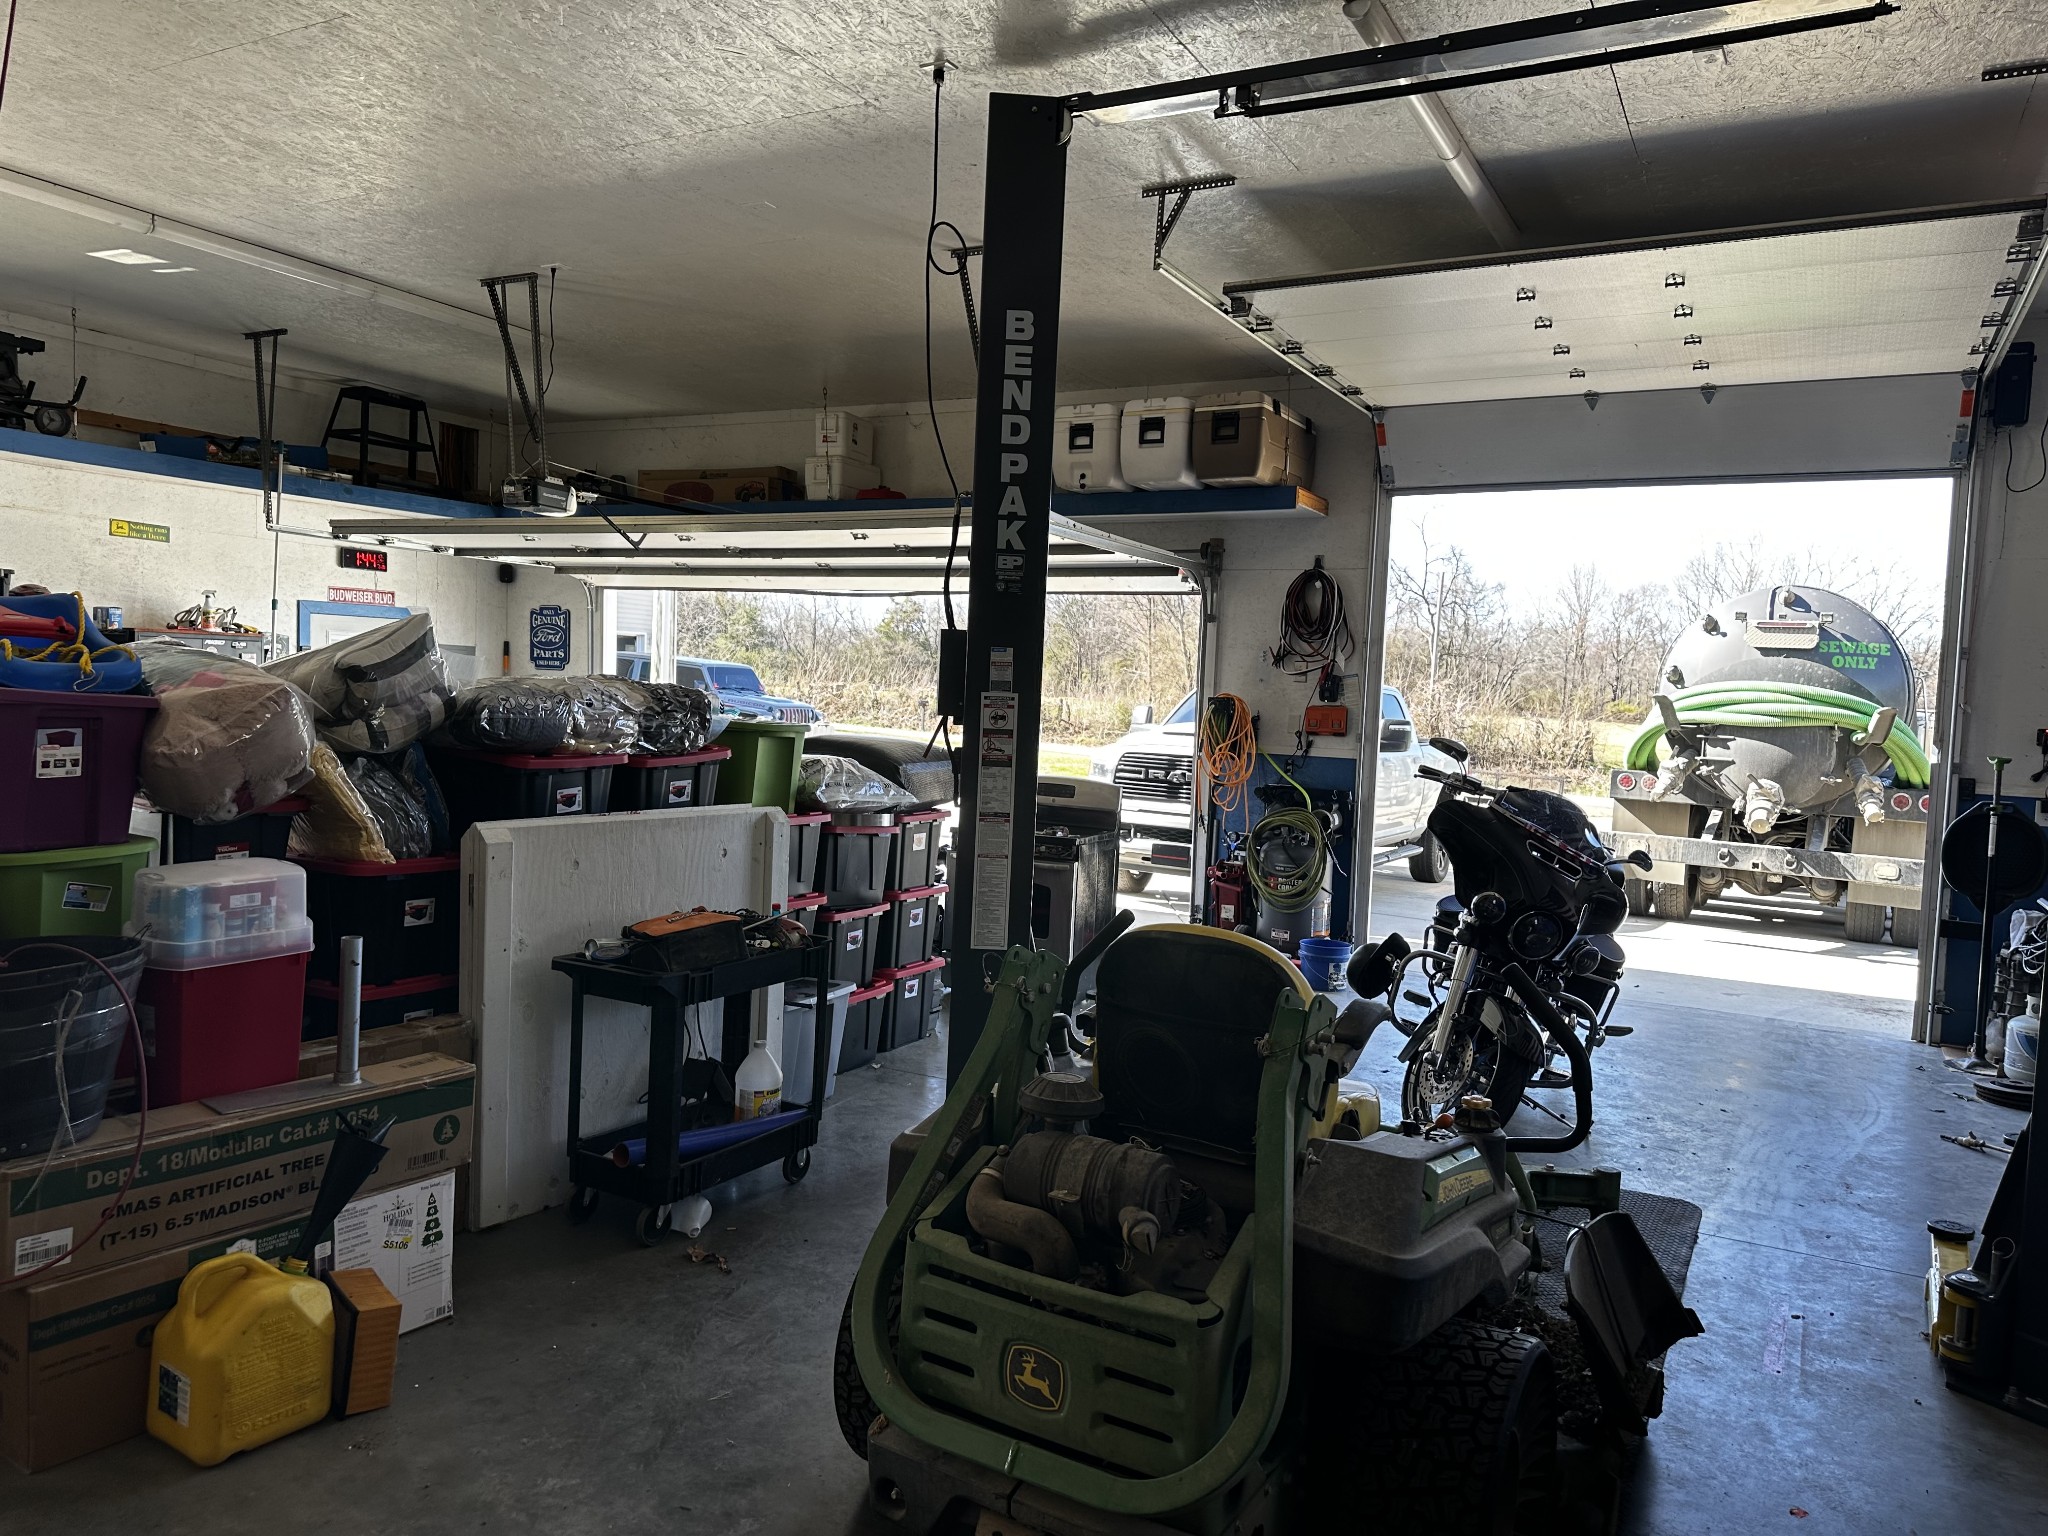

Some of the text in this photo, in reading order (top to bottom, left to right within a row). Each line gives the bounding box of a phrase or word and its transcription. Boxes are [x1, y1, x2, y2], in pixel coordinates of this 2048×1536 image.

[997, 309, 1035, 551] BENDPAK
[129, 523, 154, 532] Nothing
[154, 526, 168, 534] runs
[148, 533, 167, 541] Deere
[356, 552, 376, 568] 1:44
[997, 555, 1024, 569] BP
[329, 588, 395, 605] BUDWEISER BLVD.
[532, 614, 566, 628] GENUINE
[533, 628, 561, 642] Ford
[533, 647, 565, 659] PARTS
[1819, 640, 1891, 656] SEWAGE
[1831, 655, 1878, 670] ONLY
[87, 1162, 149, 1190] Dept.
[158, 1132, 274, 1173] 18/Modular
[279, 1117, 330, 1145] Cat.#
[167, 1168, 274, 1205] ARTIFICIAL
[280, 1153, 325, 1175] TREE
[383, 1206, 413, 1223] HOLIDAY
[100, 1222, 158, 1250] (T-15)
[383, 1239, 409, 1250] S5106
